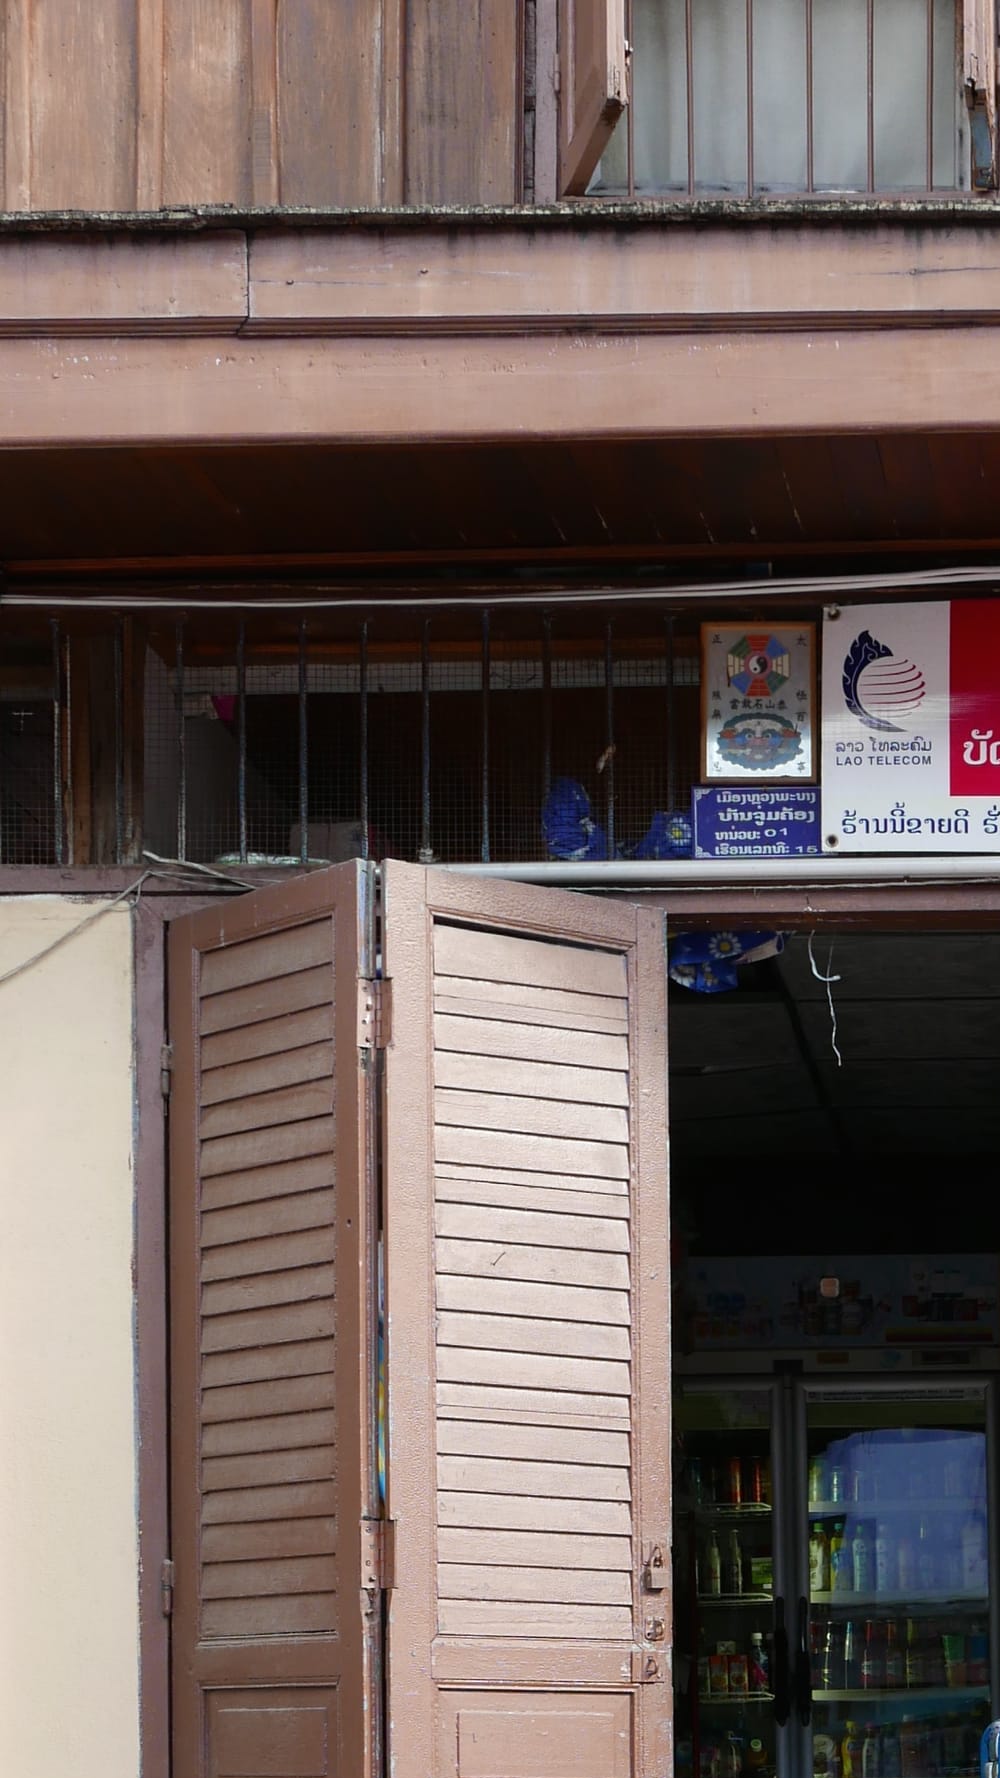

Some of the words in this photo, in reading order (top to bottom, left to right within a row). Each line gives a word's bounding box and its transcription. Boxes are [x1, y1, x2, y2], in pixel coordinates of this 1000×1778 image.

[836, 741, 864, 753] ລາວ
[869, 735, 932, 752] ໂທລະຄົມ
[836, 756, 863, 766] LAO
[868, 755, 932, 766] TELECOM
